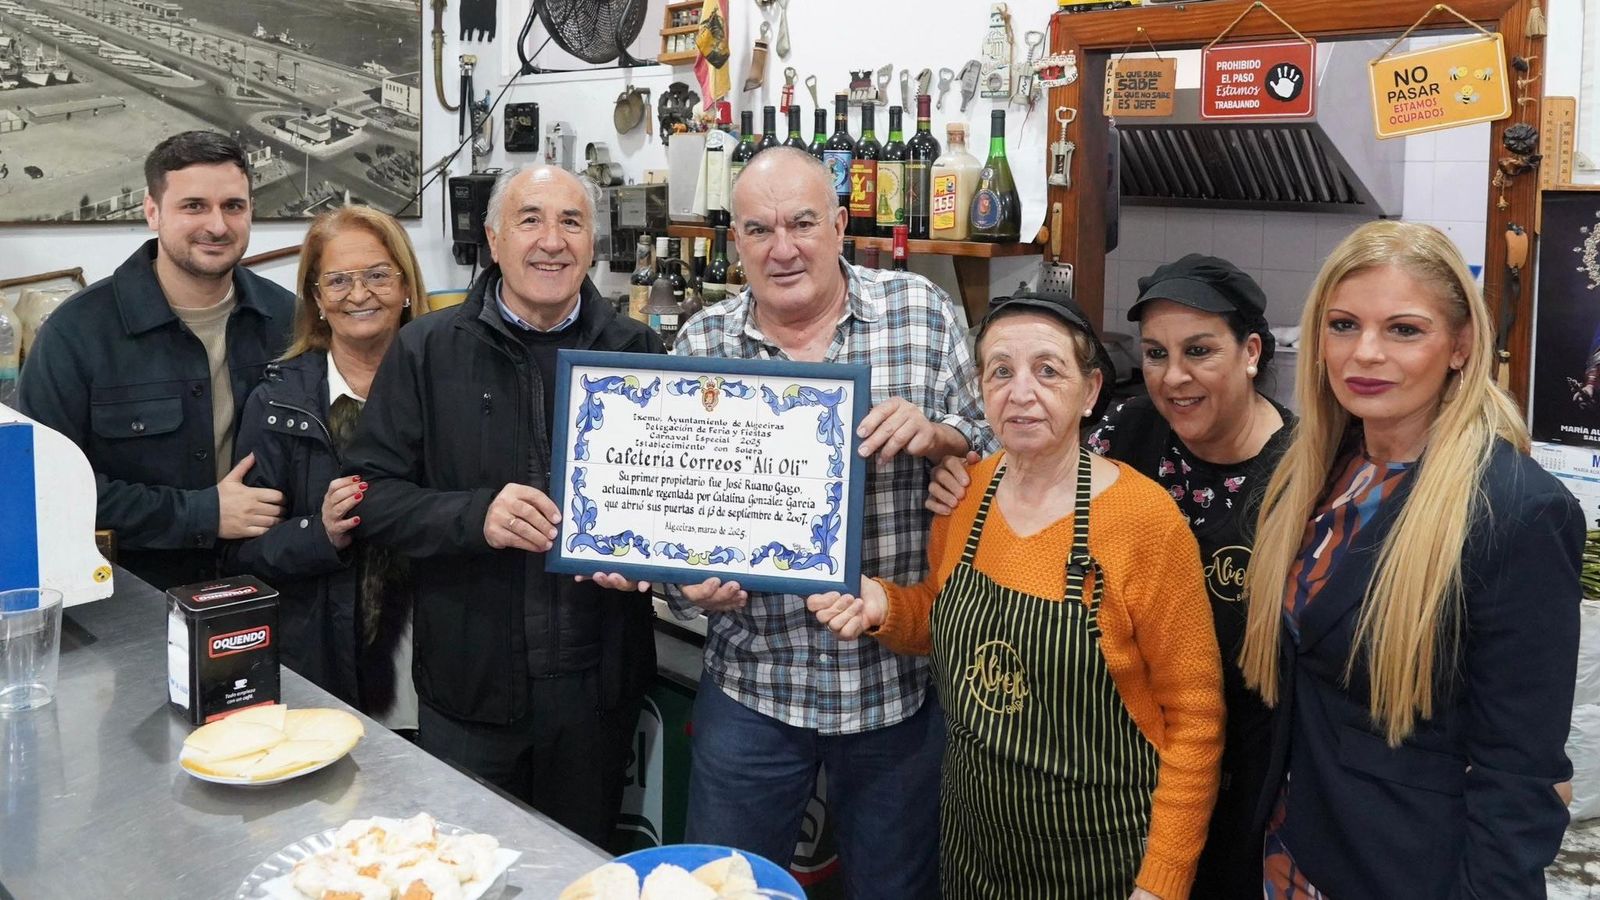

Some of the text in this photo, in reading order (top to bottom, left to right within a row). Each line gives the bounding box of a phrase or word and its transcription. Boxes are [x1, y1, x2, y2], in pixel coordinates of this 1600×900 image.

[1216, 60, 1261, 70] PROHIBIDO
[1222, 73, 1254, 83] EL PASO
[1394, 66, 1428, 88] NO
[1216, 85, 1260, 96] Estamos
[1388, 82, 1440, 104] PASAR
[1118, 100, 1156, 110] ES JEFE
[1215, 100, 1260, 110] TRABAJANDO
[1394, 98, 1436, 113] ESTAMOS
[1390, 108, 1444, 125] OCUPADOS
[935, 196, 954, 212] 155
[646, 422, 692, 434] Delegación
[696, 426, 706, 434] de
[708, 427, 730, 435] Feria
[741, 428, 772, 438] Fiestas
[668, 416, 728, 426] Ayuntamiento
[745, 420, 784, 430] Algeciras
[1560, 424, 1590, 435] MARÍA
[636, 439, 705, 451] Establecimiento
[736, 446, 762, 454] Solera
[650, 432, 760, 447] Carnaval Especial 2025
[606, 447, 674, 468] Cafetería
[680, 452, 742, 472] Correos
[618, 470, 629, 481] Su
[631, 472, 658, 484] primer
[661, 475, 706, 488] propietario
[708, 476, 722, 488] fue
[724, 478, 742, 491] José
[745, 479, 773, 492] Ruano
[602, 484, 815, 510] actualmente regentada por Catalina González García
[604, 500, 618, 512] que
[622, 500, 644, 510] abrió
[647, 504, 662, 512] sus
[664, 504, 694, 516] puertas
[698, 507, 705, 515] el
[716, 506, 726, 516] de
[728, 508, 772, 521] septiembre
[774, 511, 783, 520] de
[698, 526, 717, 534] marzo
[719, 526, 726, 535] de
[212, 630, 266, 650] OQUENDO
[1006, 700, 1024, 714] BAR
